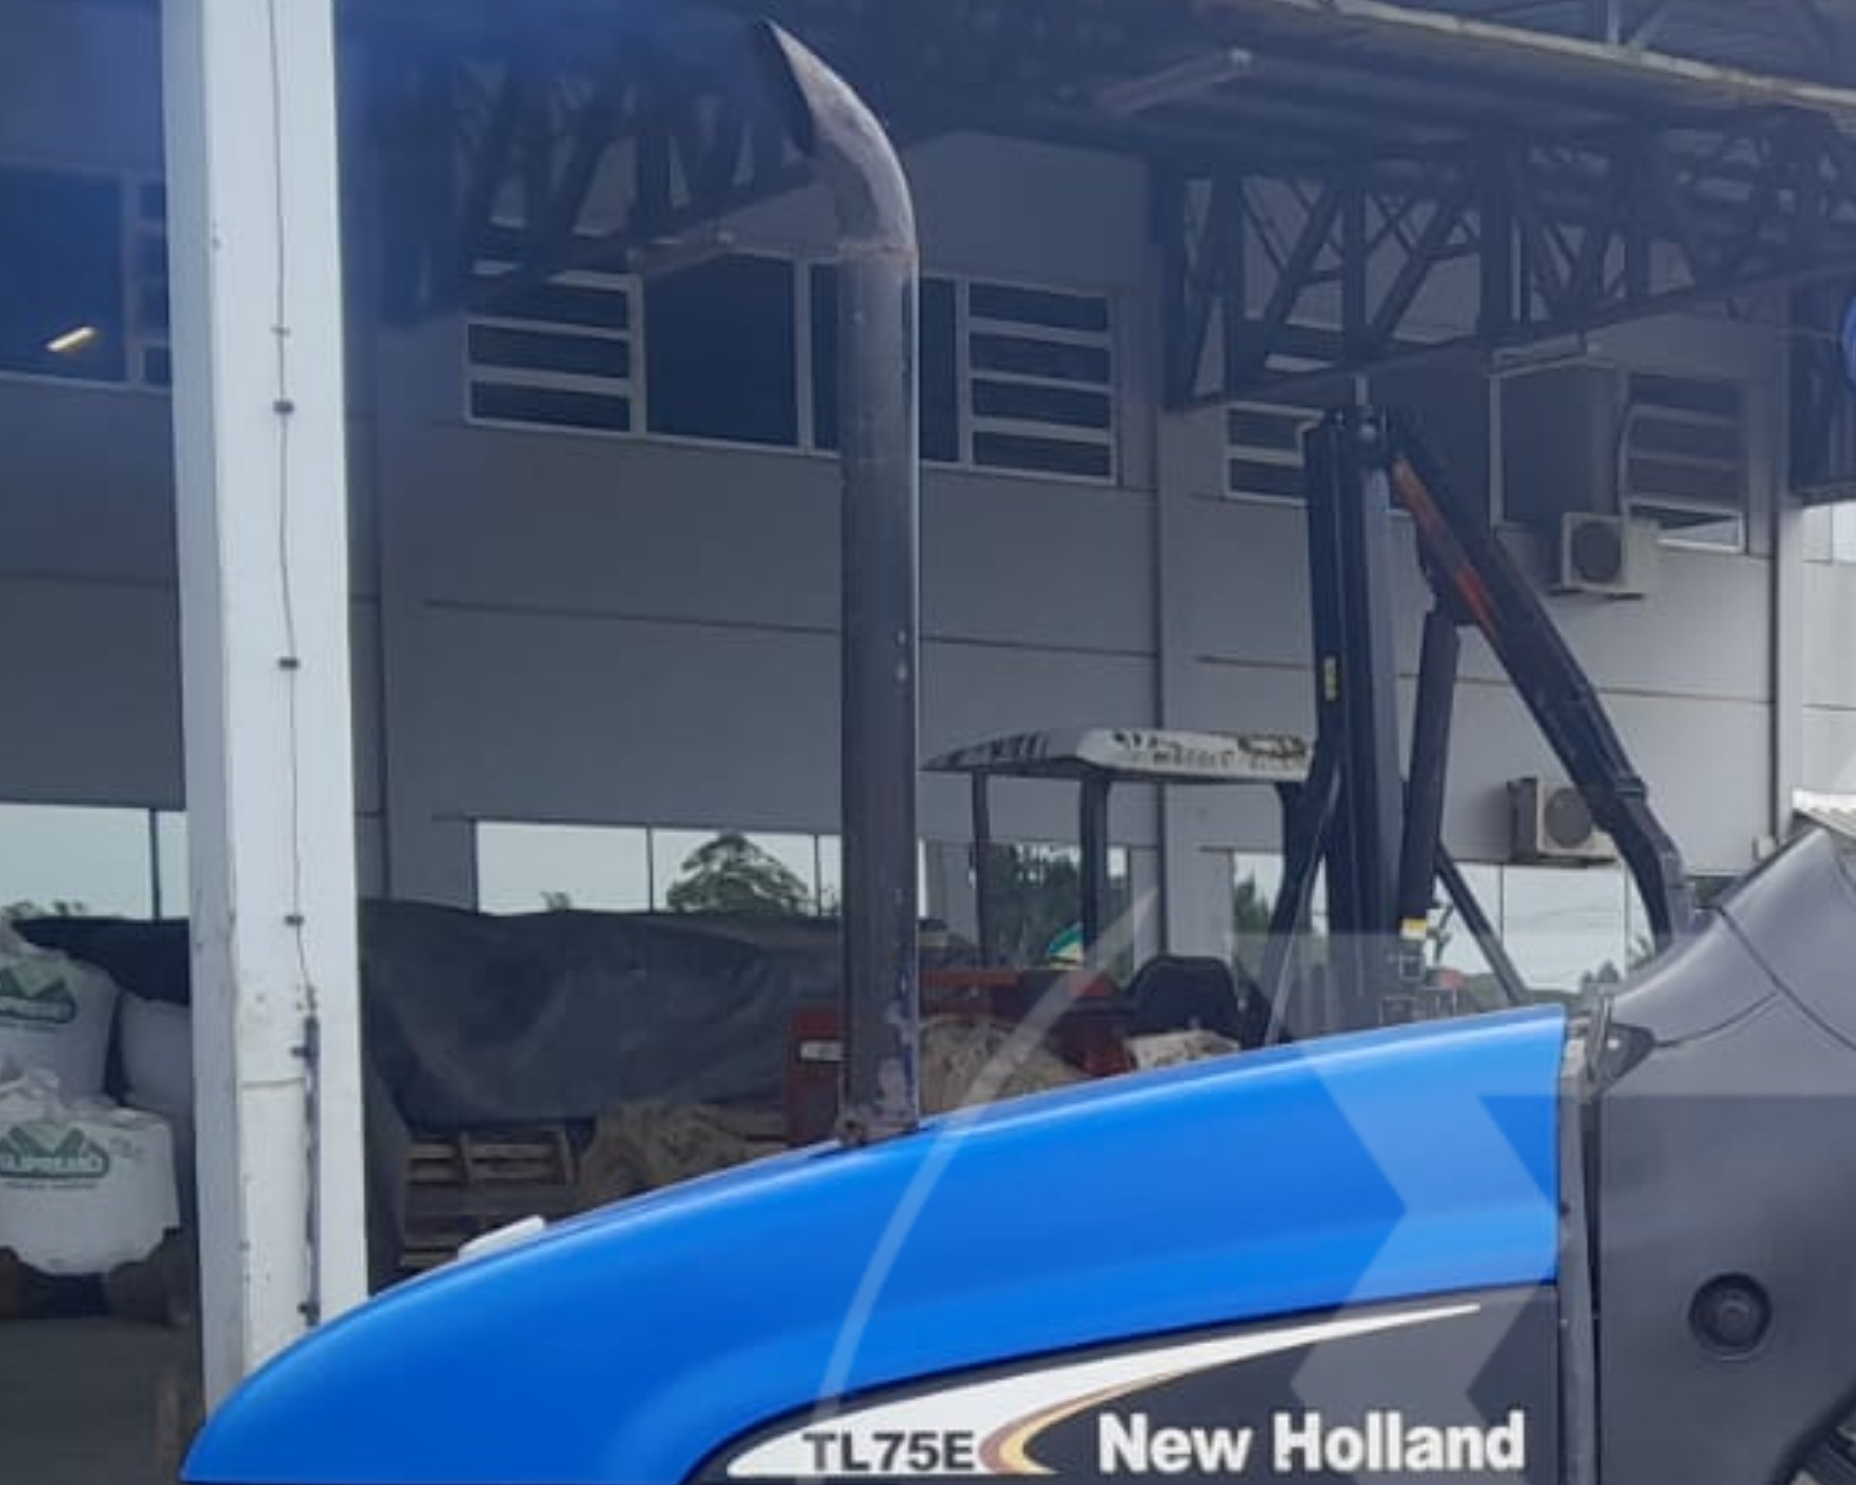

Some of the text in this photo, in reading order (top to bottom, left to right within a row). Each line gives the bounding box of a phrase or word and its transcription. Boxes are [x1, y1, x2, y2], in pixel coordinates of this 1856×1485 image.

[801, 1430, 974, 1471] TL75E
[1098, 1410, 1526, 1473] New Holland
